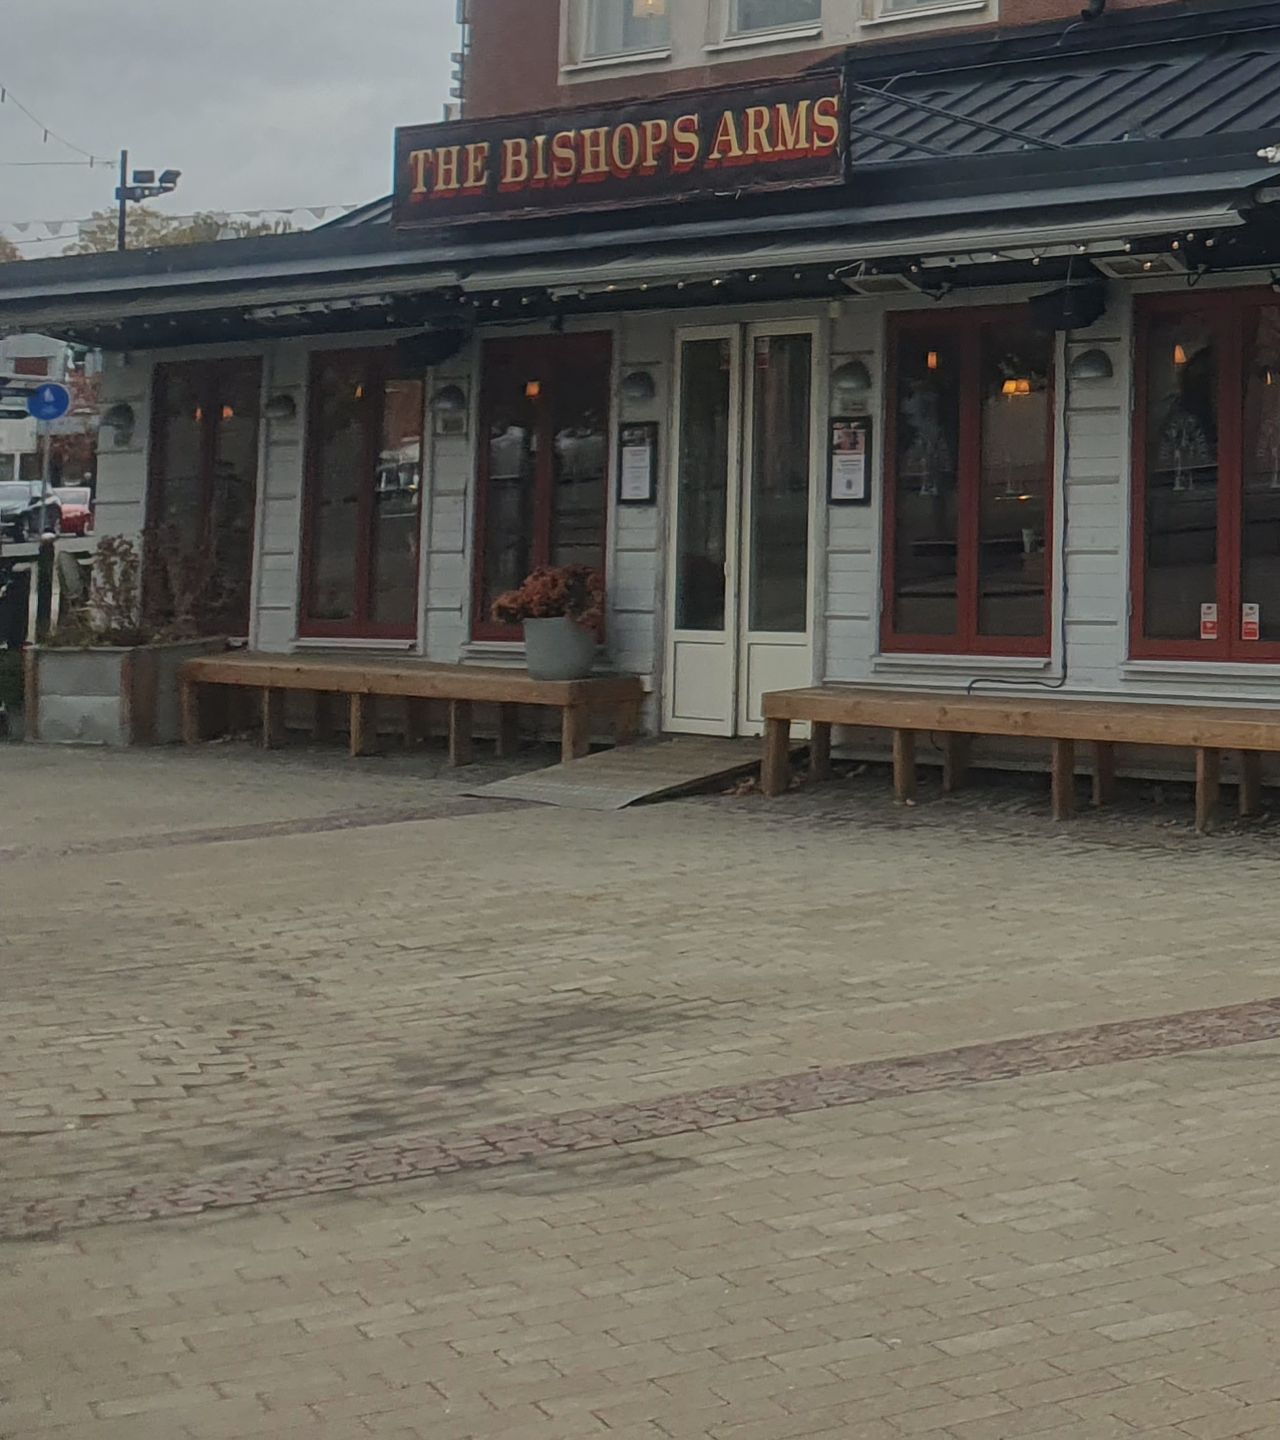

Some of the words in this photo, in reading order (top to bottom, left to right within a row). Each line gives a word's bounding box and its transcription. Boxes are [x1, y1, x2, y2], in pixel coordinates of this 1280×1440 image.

[408, 140, 489, 197] THE
[500, 112, 700, 187] BISHOPS
[708, 94, 841, 162] ARMS
